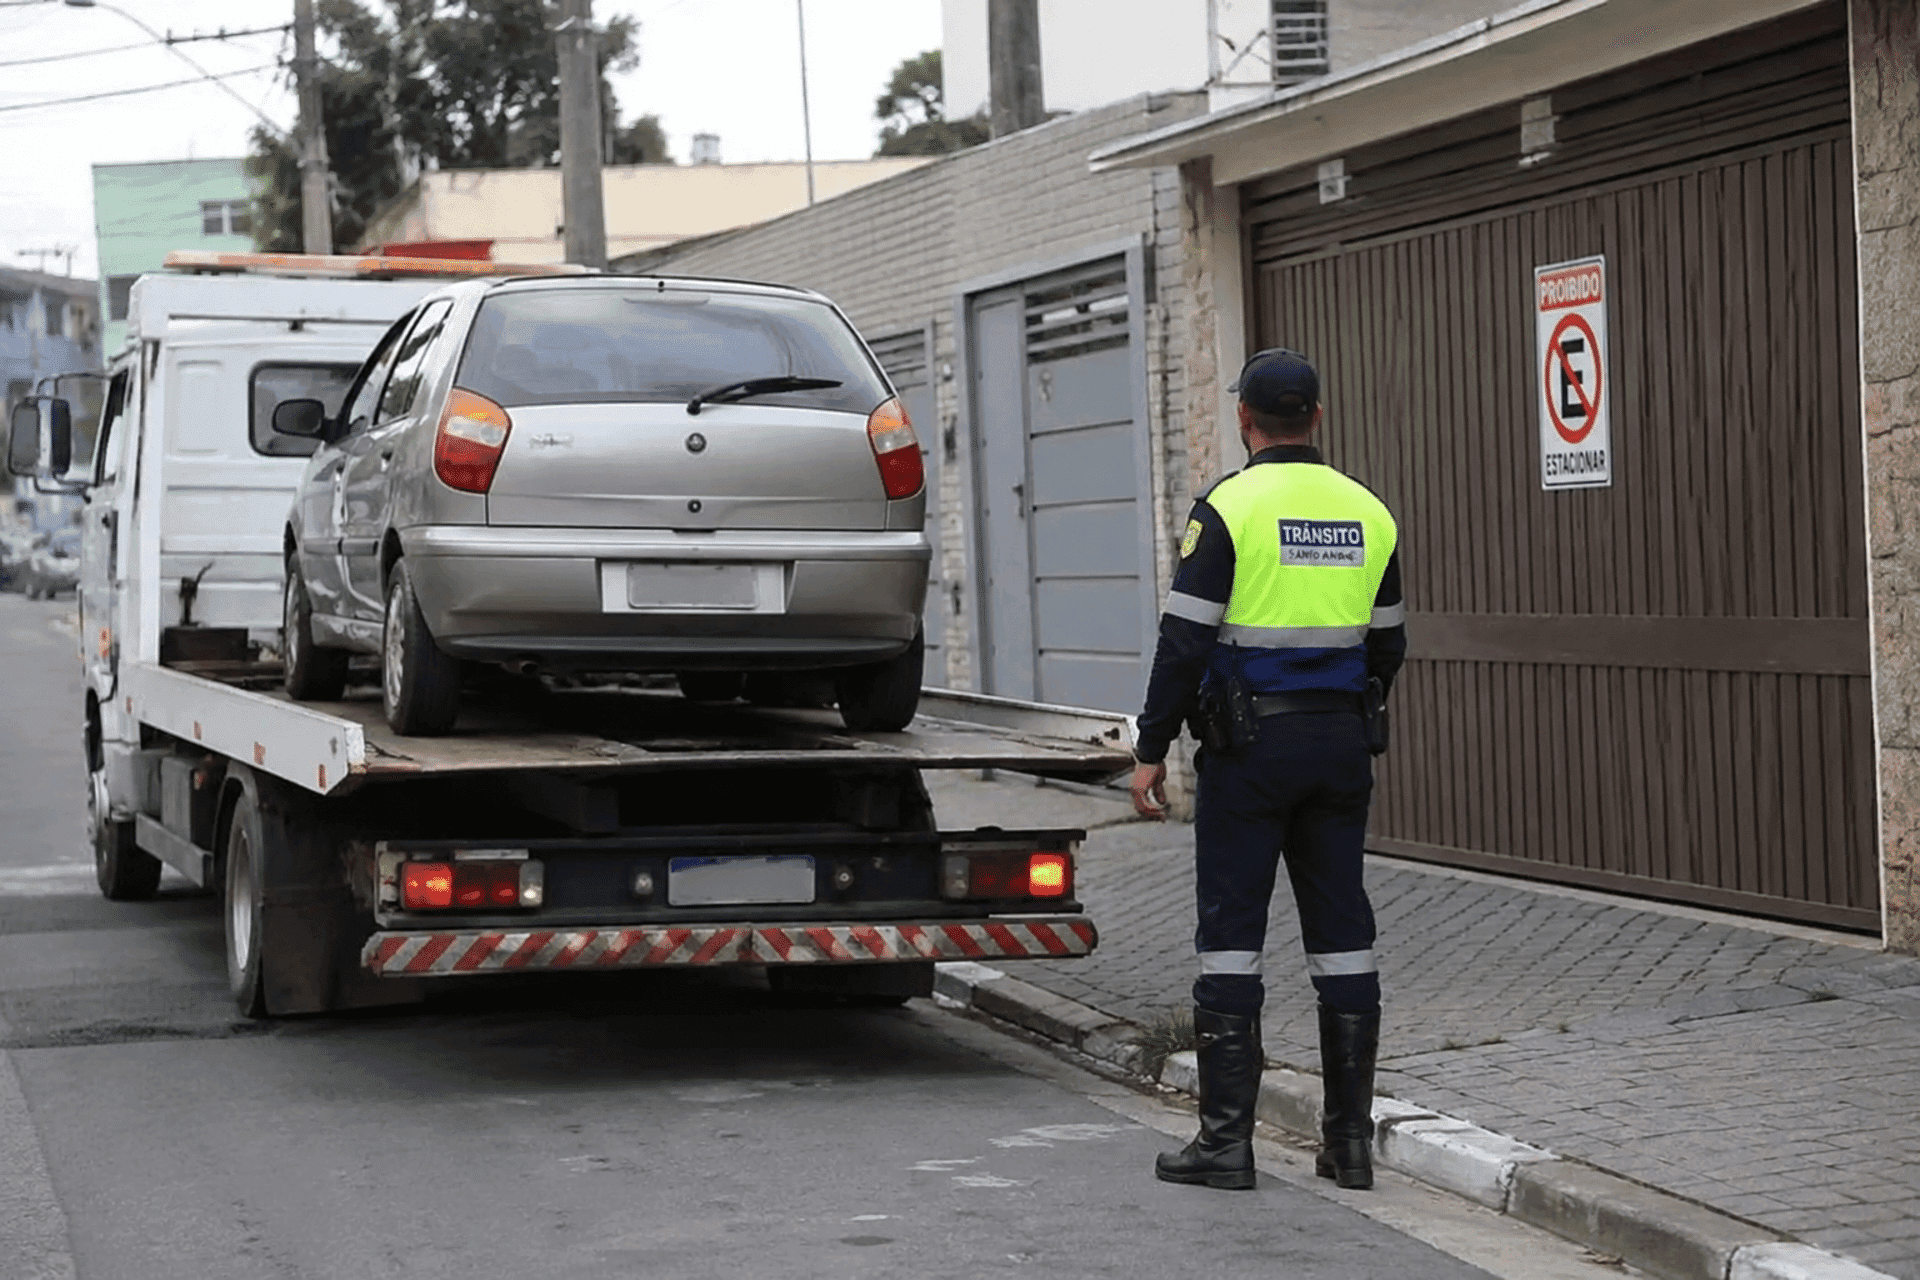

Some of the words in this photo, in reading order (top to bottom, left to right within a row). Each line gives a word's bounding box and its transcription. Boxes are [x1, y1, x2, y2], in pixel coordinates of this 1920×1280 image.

[1541, 271, 1599, 304] PROIBIDO
[1546, 450, 1605, 476] ESTACIONAR
[1283, 523, 1360, 544] TRÂNSITO
